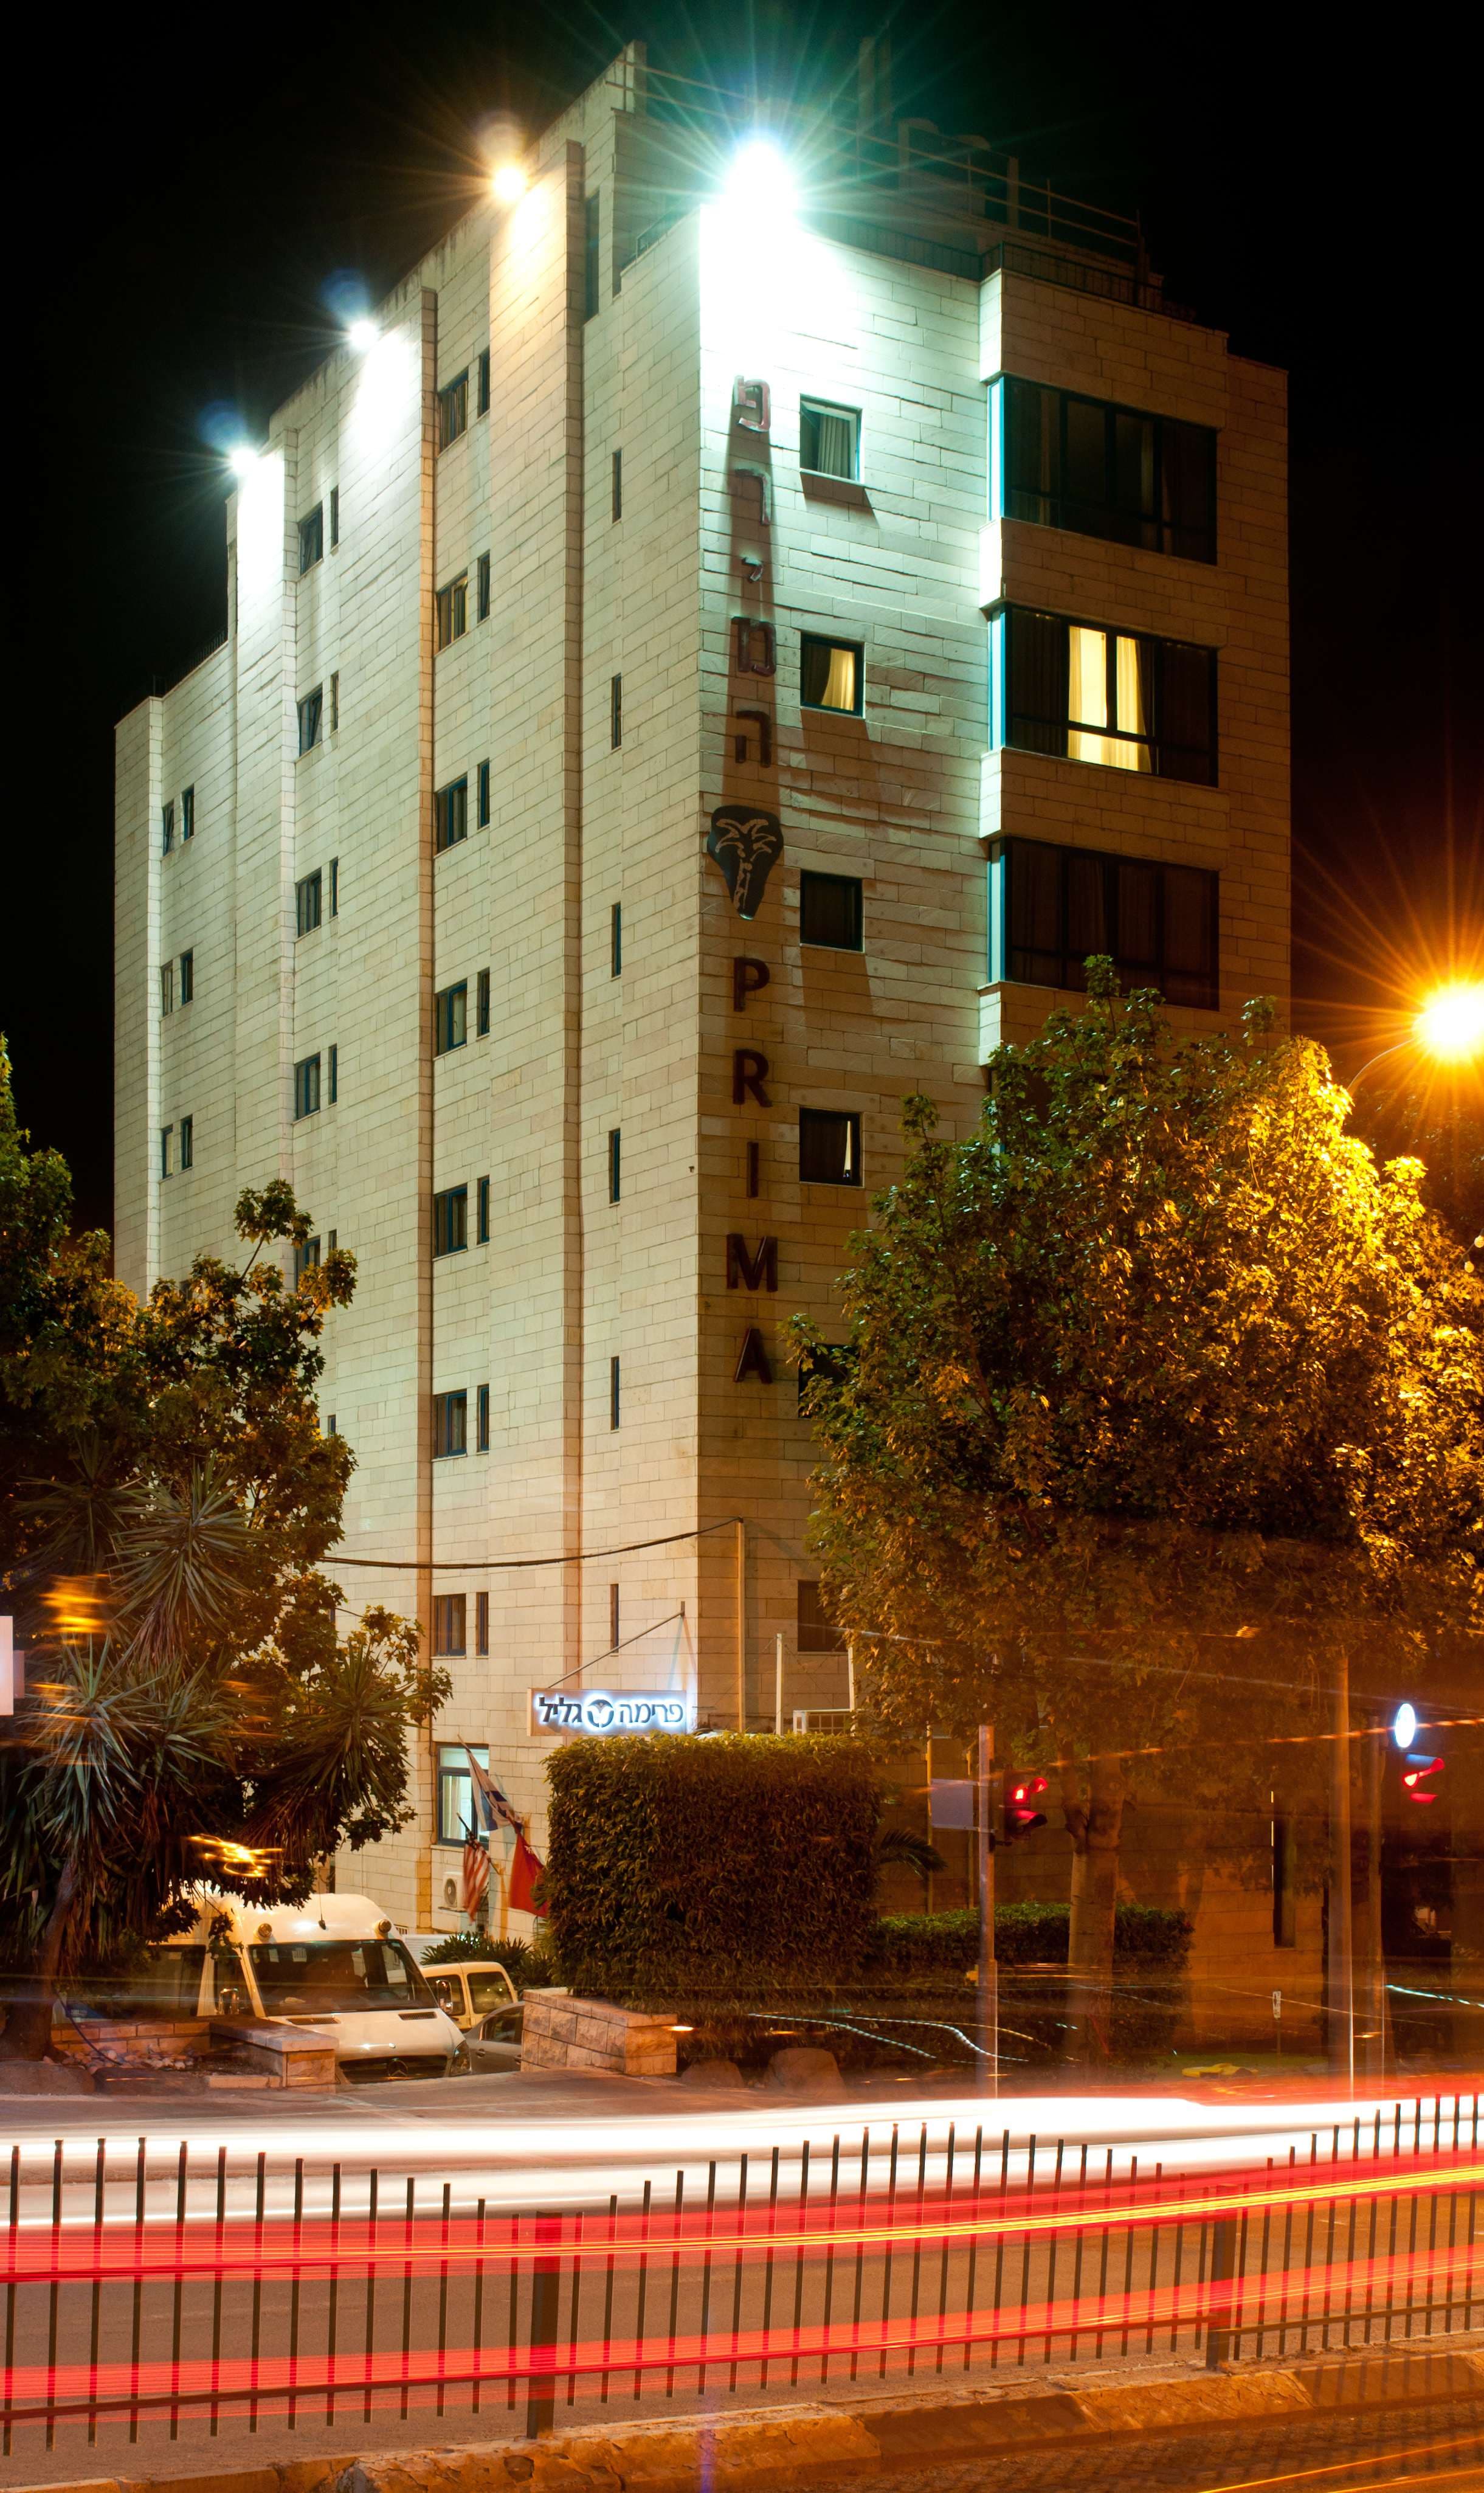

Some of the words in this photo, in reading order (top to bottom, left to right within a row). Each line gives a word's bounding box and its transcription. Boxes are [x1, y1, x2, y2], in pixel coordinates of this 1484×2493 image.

[732, 375, 776, 769] פרימה
[726, 955, 778, 1385] PRIMA
[539, 1696, 582, 1723] גליל
[619, 1703, 683, 1723] פרימה
